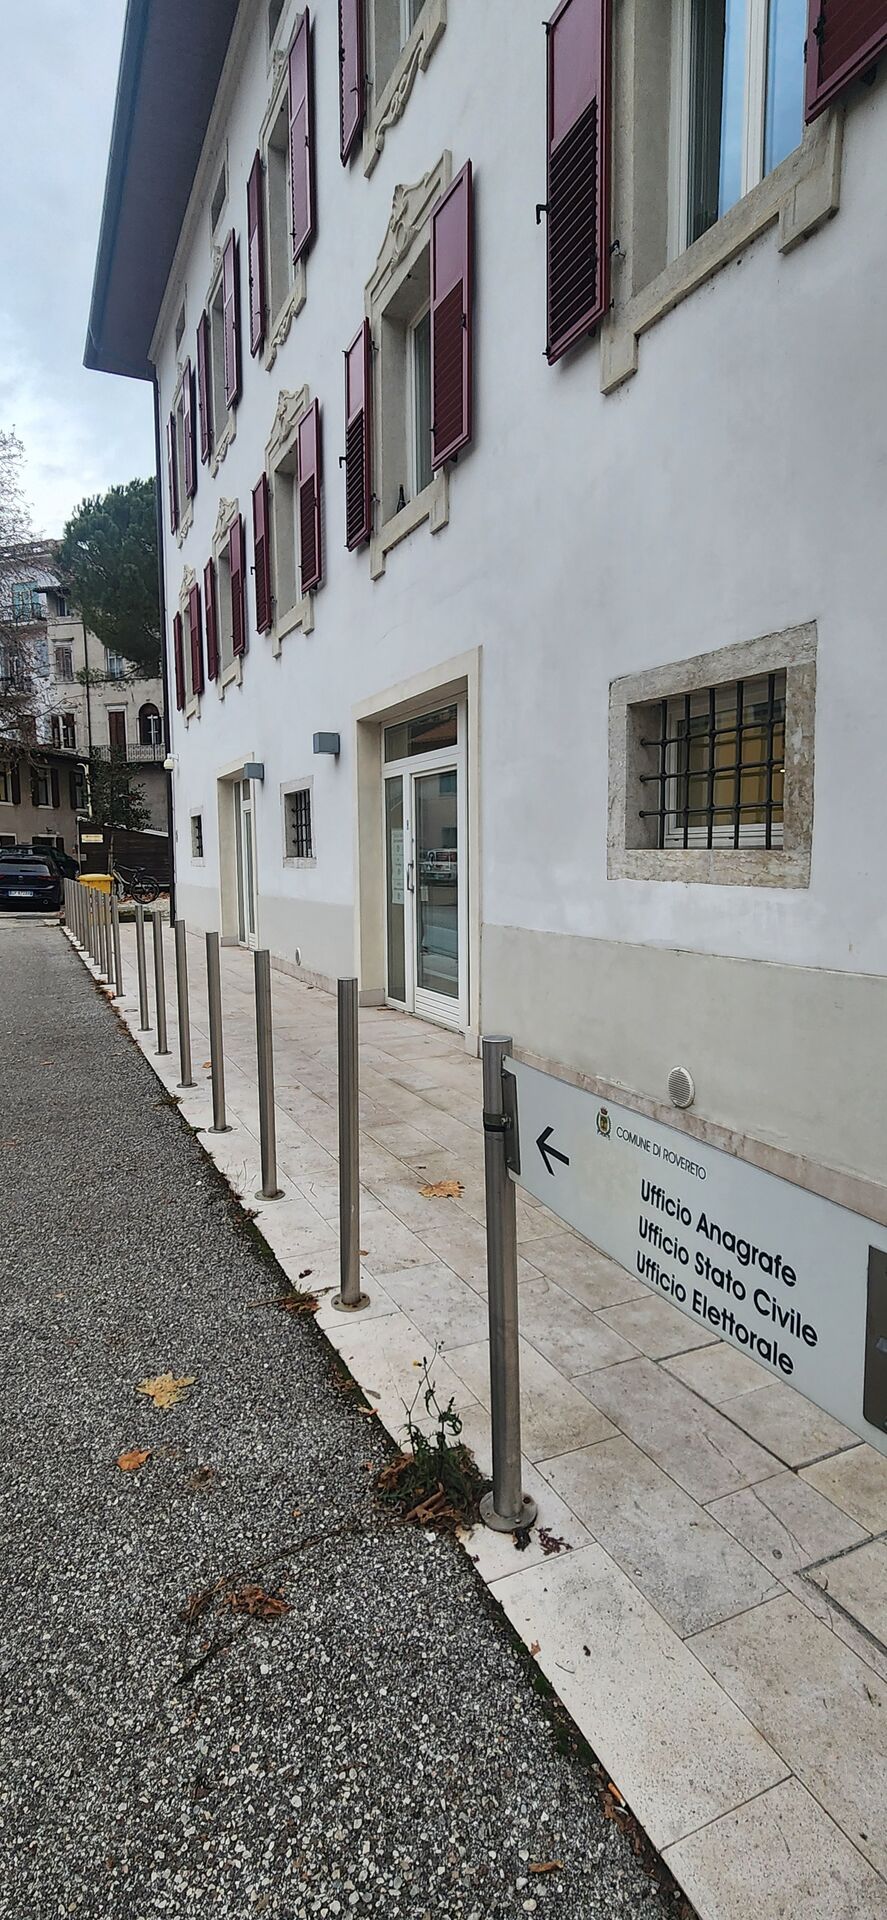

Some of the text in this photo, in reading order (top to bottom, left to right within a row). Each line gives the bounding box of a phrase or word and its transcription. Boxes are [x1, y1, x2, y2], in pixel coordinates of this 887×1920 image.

[616, 1126, 707, 1180] COMUNE DI ROVERETO
[638, 1215, 818, 1347] Ufficio Stato Civile
[641, 1178, 797, 1287] Ufficio Anagrafe
[636, 1250, 794, 1375] Ufficio Elettorale
